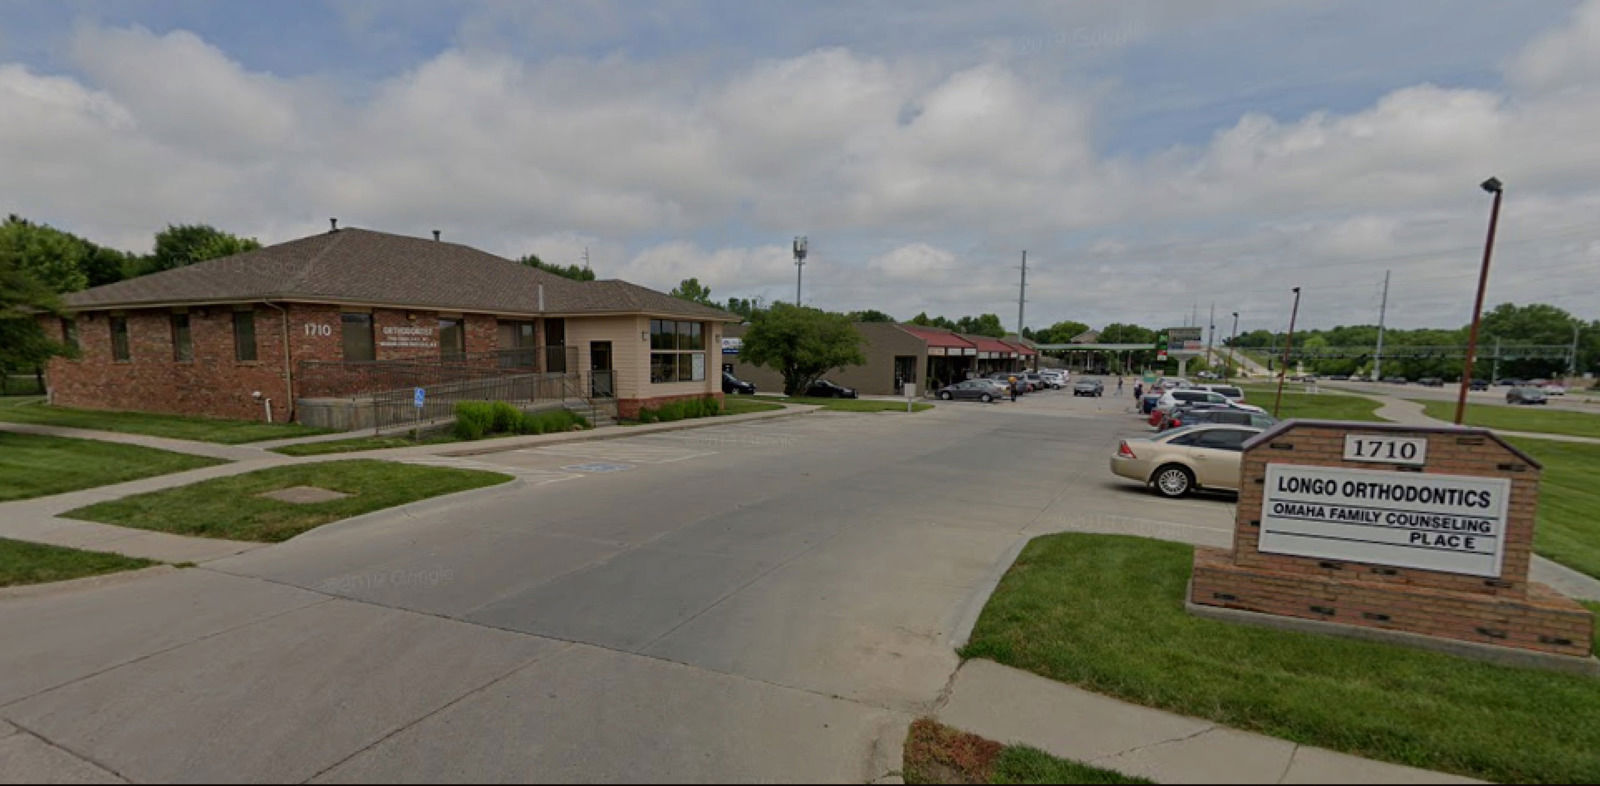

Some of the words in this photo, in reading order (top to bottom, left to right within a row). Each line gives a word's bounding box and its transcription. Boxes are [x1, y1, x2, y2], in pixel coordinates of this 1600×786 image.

[304, 323, 332, 337] 1710
[1353, 439, 1417, 459] 1710
[1278, 476, 1337, 496] LONGO
[1343, 481, 1491, 508] ORTHODONTICS
[1273, 503, 1326, 518] OMAHA
[1329, 507, 1382, 524] FAMILY
[1386, 512, 1491, 533] COUNSELING
[1410, 532, 1475, 549] PLACE
